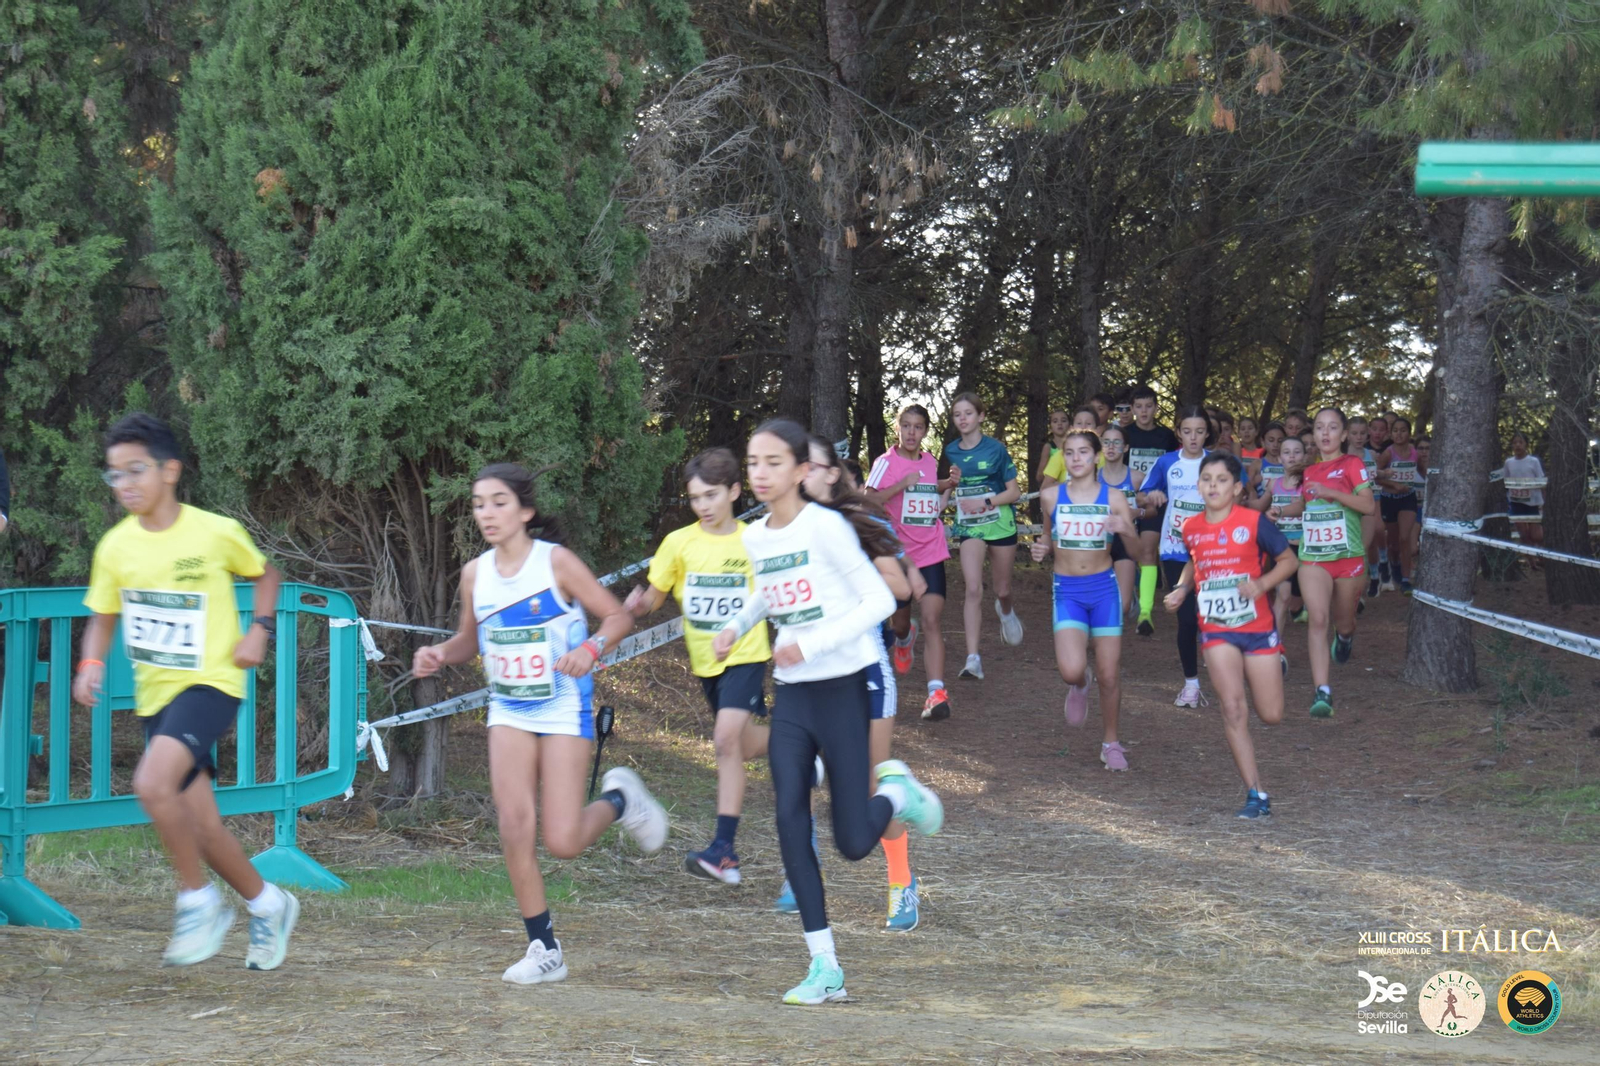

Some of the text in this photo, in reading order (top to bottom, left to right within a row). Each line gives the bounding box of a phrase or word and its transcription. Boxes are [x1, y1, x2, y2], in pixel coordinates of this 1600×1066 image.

[907, 500, 940, 514] 5154
[1061, 521, 1106, 537] 7107
[1306, 526, 1344, 542] 7133
[689, 596, 744, 616] 5769
[130, 615, 198, 648] 5771
